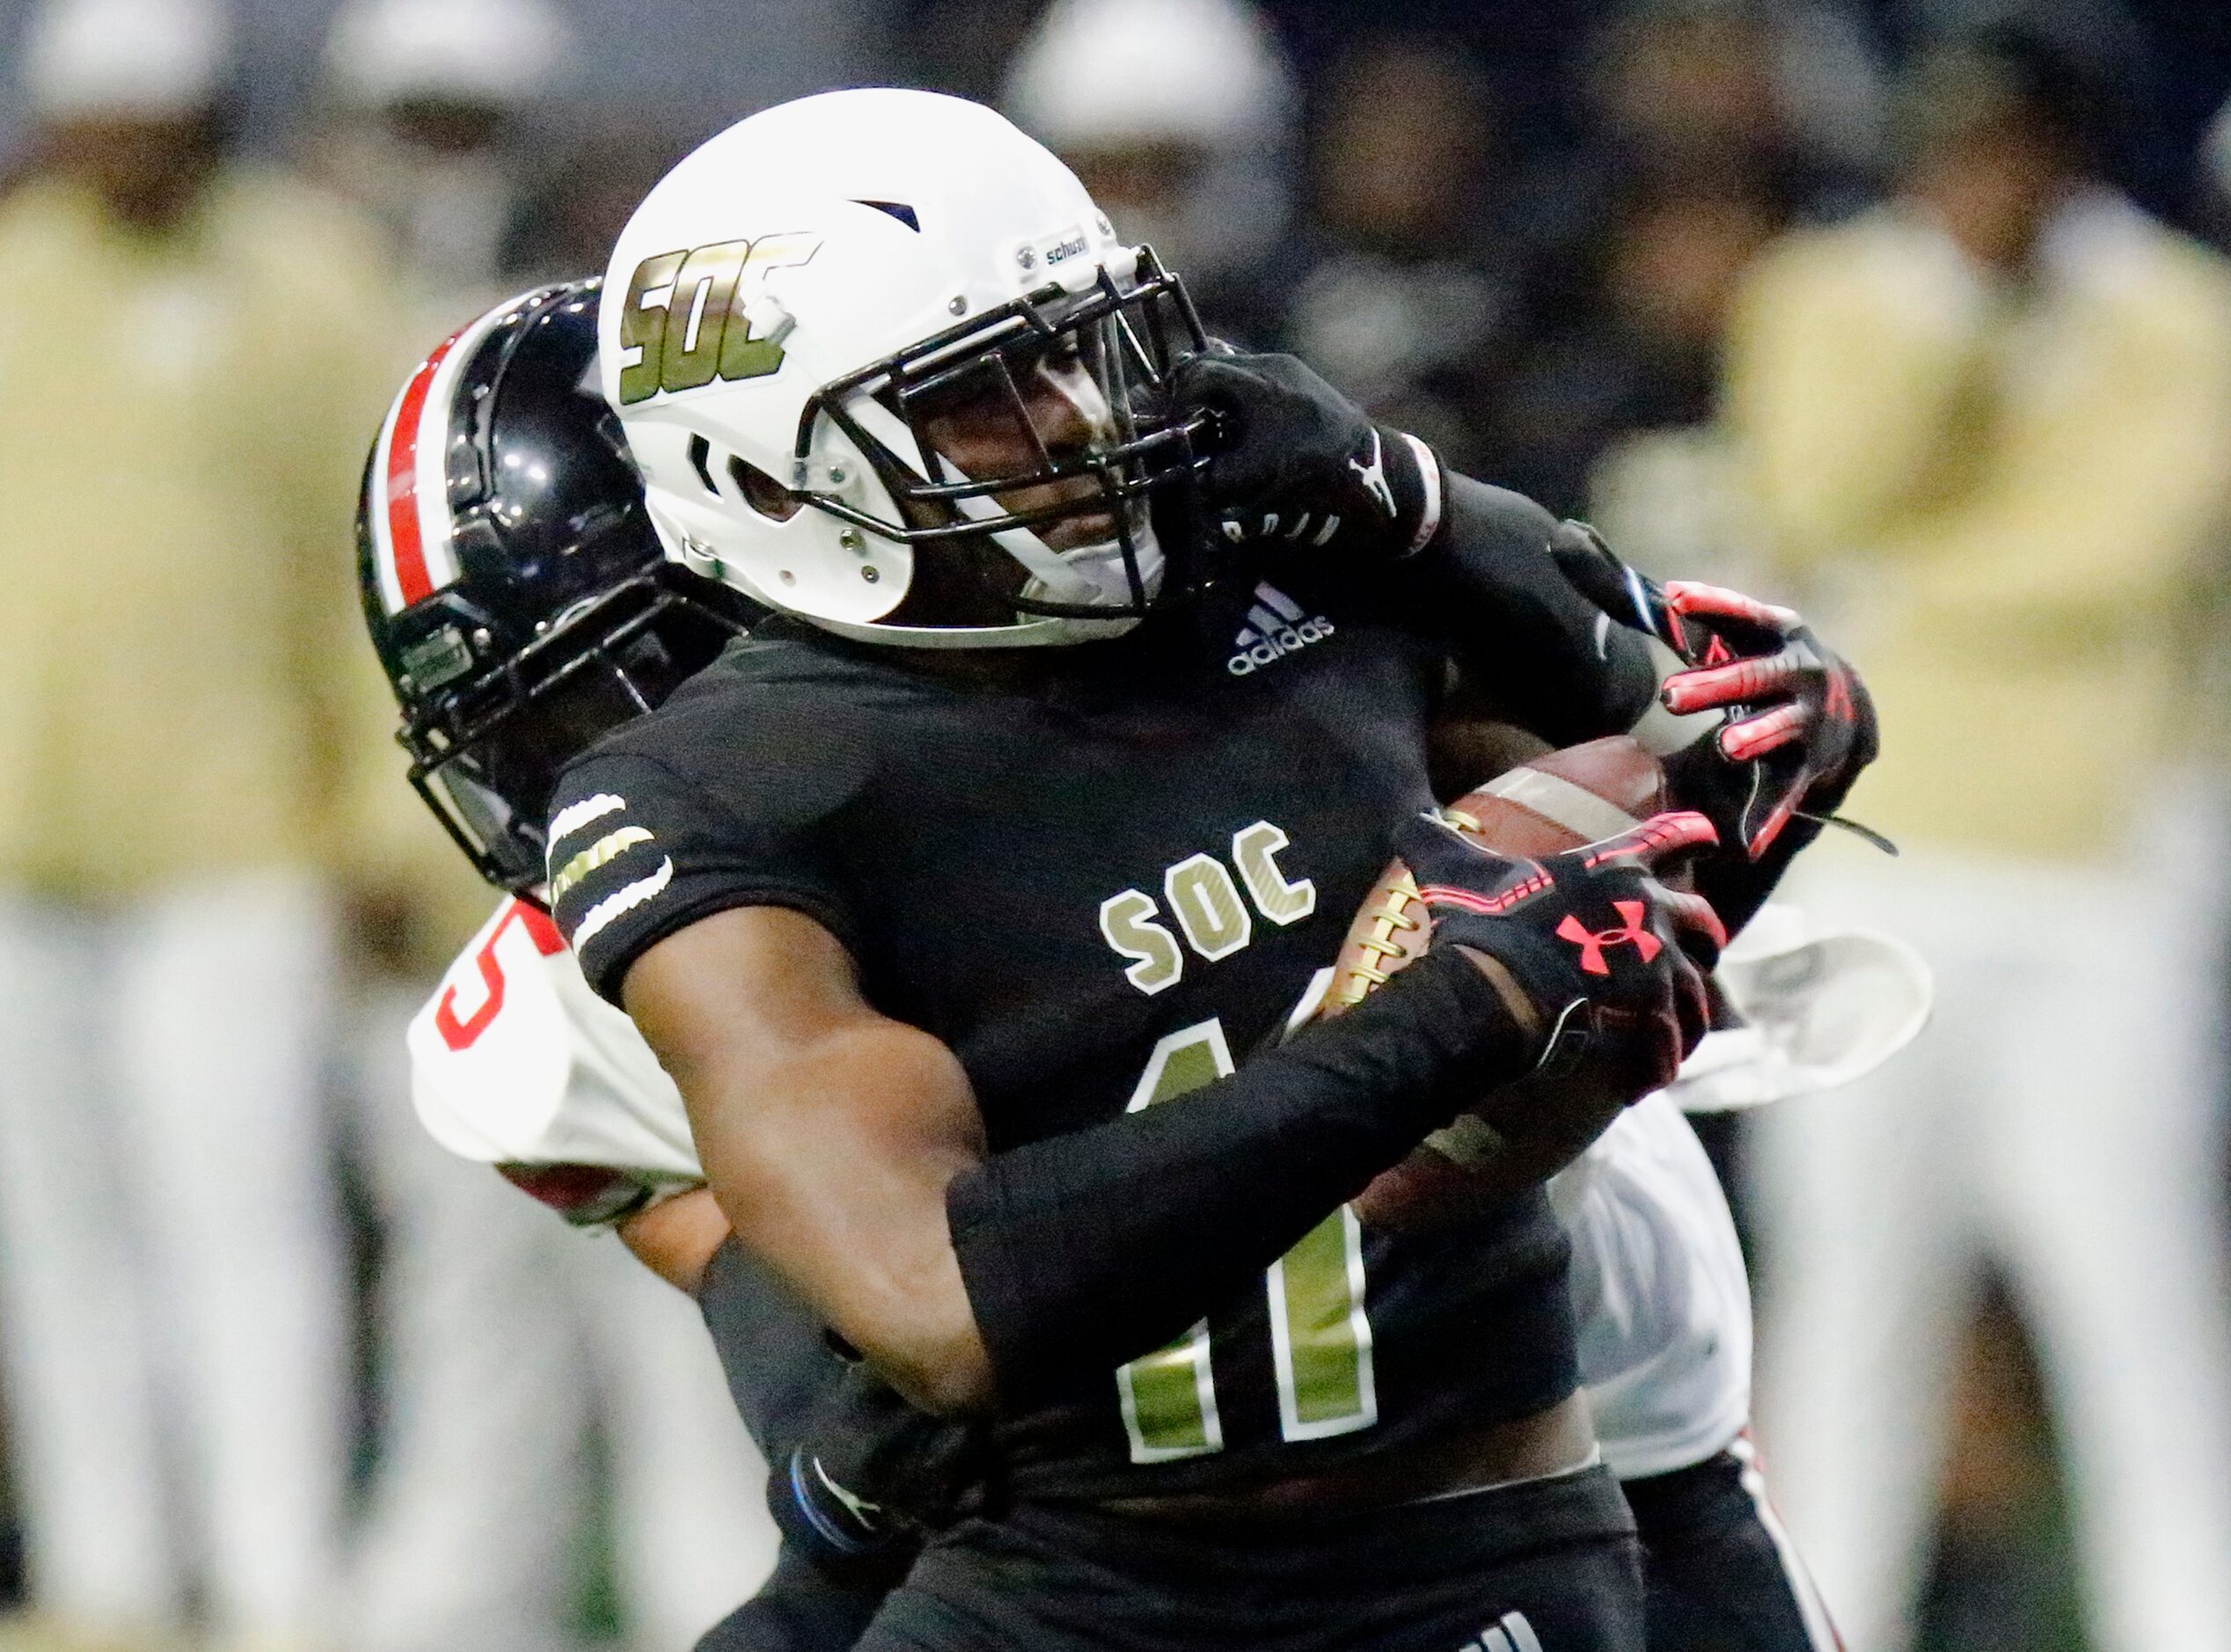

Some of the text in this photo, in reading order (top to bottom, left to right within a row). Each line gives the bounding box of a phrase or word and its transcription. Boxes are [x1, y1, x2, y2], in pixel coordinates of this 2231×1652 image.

[618, 231, 825, 406] SOC
[1227, 615, 1335, 676] adidas
[1100, 819, 1317, 997] SOC
